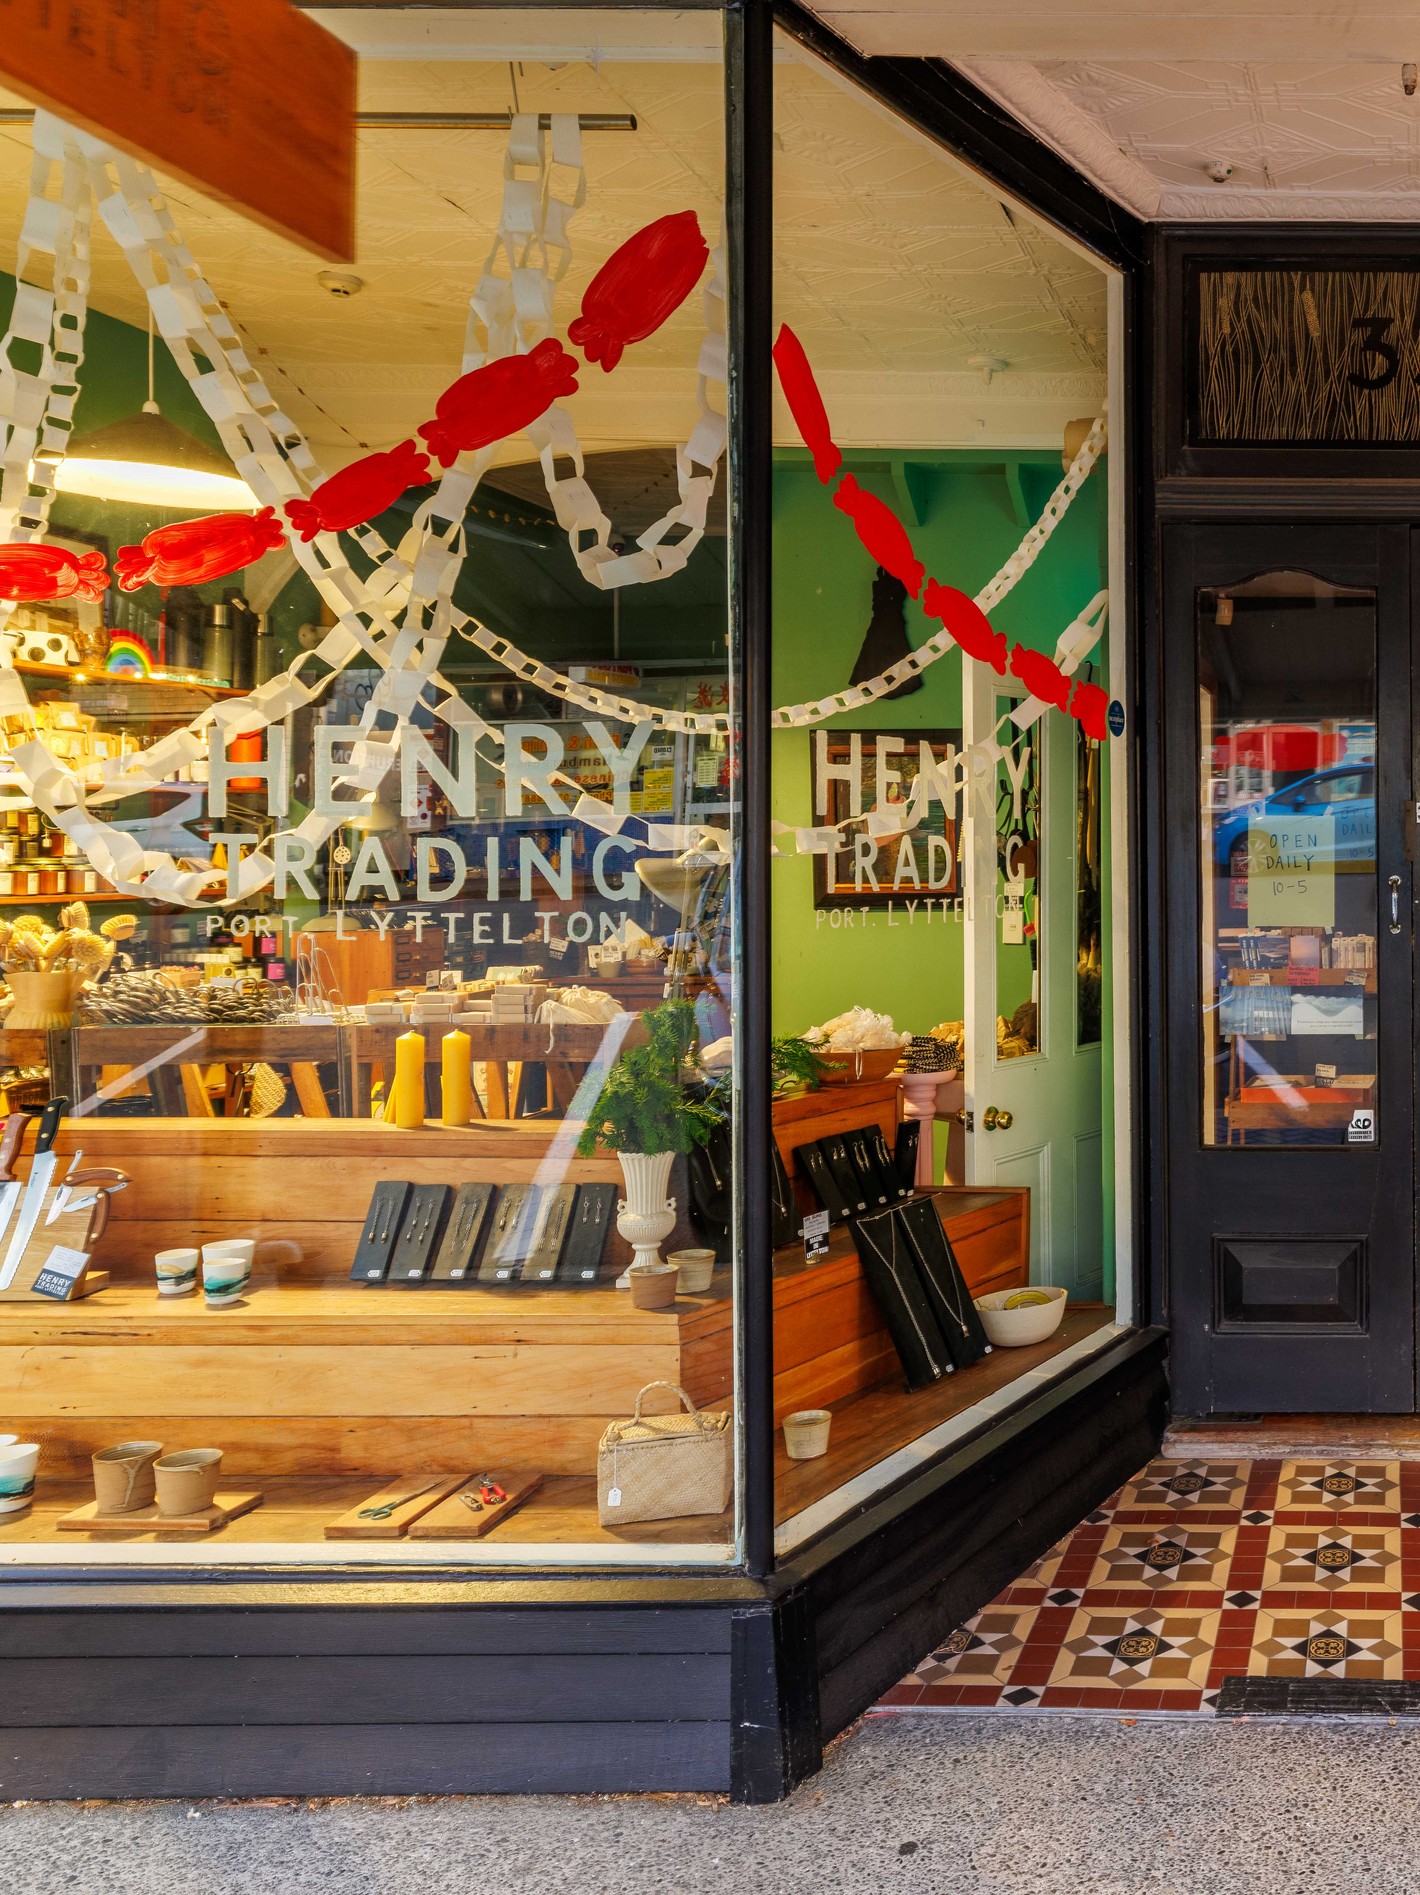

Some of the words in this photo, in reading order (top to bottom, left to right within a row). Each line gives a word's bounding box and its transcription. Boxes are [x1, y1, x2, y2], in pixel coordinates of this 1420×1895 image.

[208, 721, 657, 817] HENRY
[816, 730, 1031, 819] HENRY
[1270, 834, 1317, 849] OPEN
[209, 833, 641, 901] TRADING
[1266, 855, 1314, 871] DAILY
[336, 910, 627, 943] LYTTELTON
[37, 1280, 67, 1293] TRADING
[39, 1272, 72, 1288] HENRY
